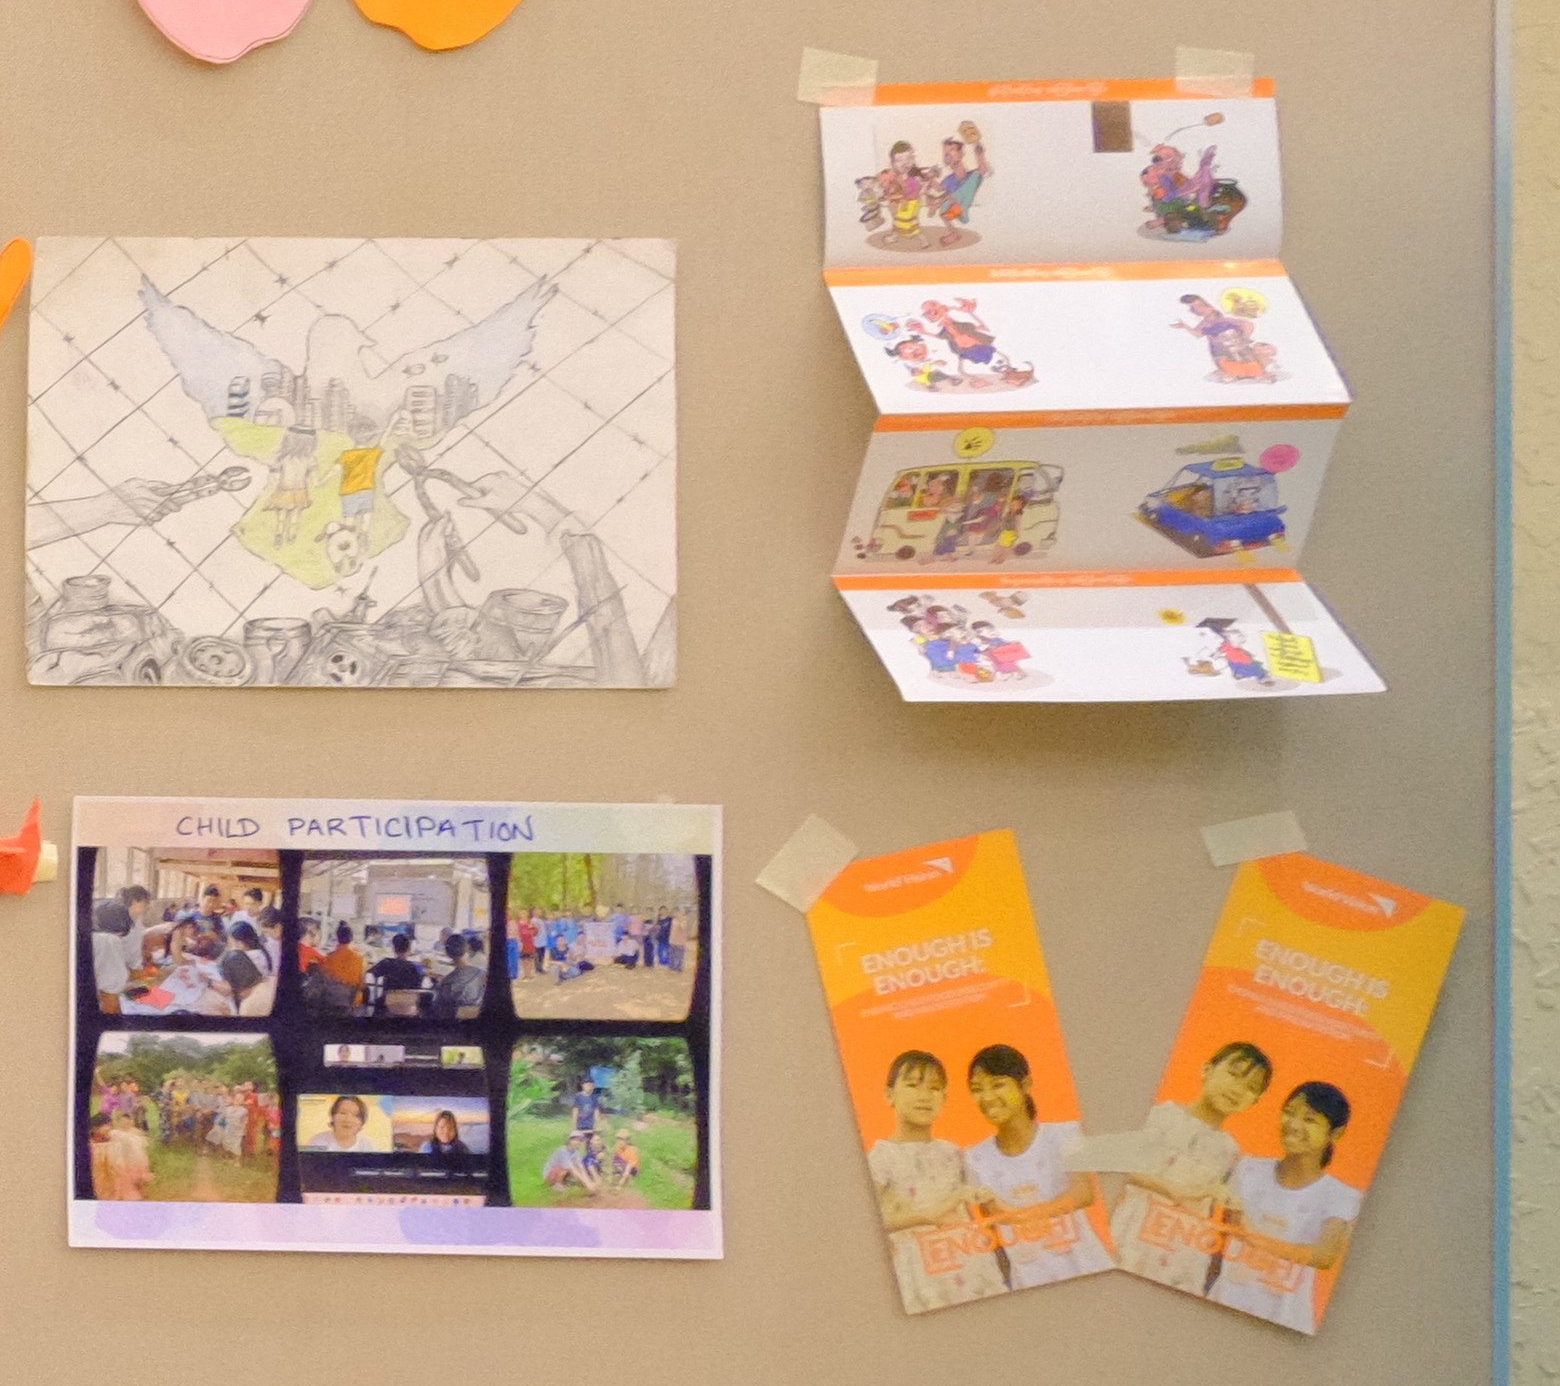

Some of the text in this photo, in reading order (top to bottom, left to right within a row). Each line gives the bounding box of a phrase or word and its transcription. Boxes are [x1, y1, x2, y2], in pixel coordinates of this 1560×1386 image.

[176, 814, 536, 843] CHILD PARTICIPATION
[860, 927, 995, 974] ENOUGH IS
